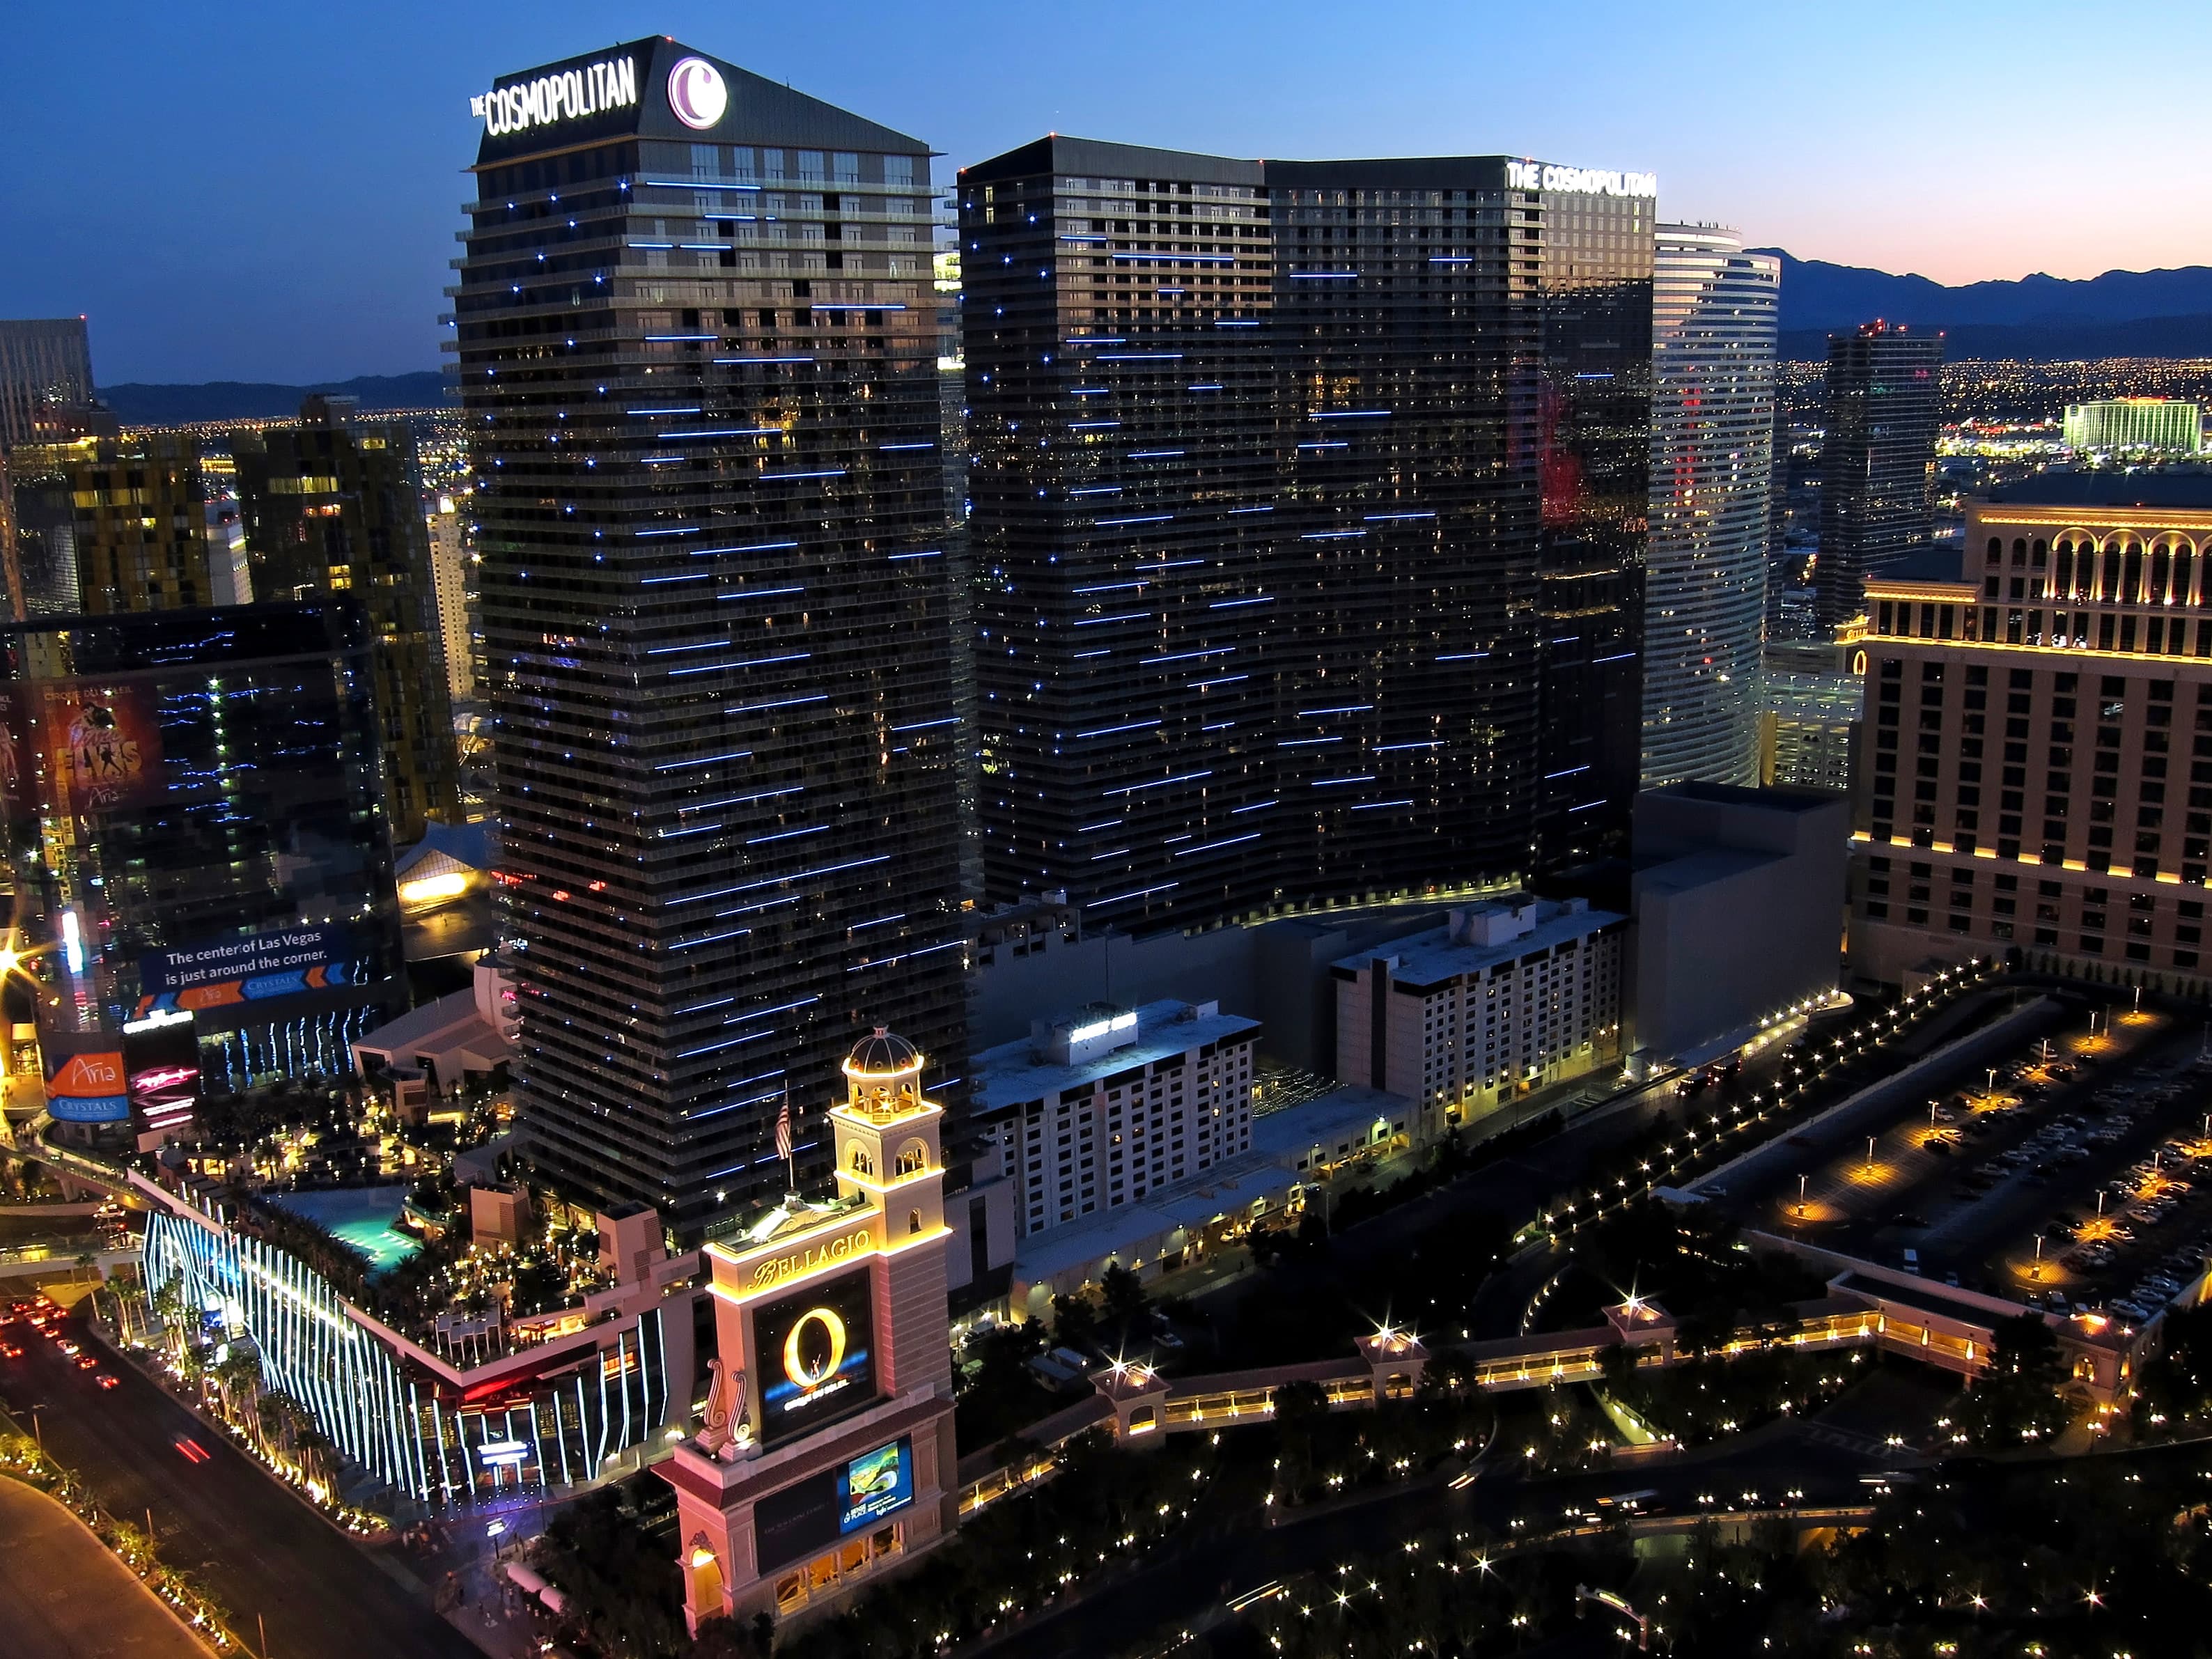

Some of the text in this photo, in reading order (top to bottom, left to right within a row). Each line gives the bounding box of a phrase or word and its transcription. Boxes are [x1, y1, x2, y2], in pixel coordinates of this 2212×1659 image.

[469, 56, 637, 137] THE COSMOPOLITAN
[1506, 162, 1657, 198] THE COSMOPOLITAN
[56, 740, 143, 779] ELVIS
[166, 932, 322, 965] The center of Las Vegas
[166, 949, 327, 986] is just around the corner.
[72, 1059, 116, 1086] Aria
[59, 1099, 118, 1112] CRYSTALS
[747, 1230, 871, 1291] BELLAGIO
[782, 1307, 846, 1387] O
